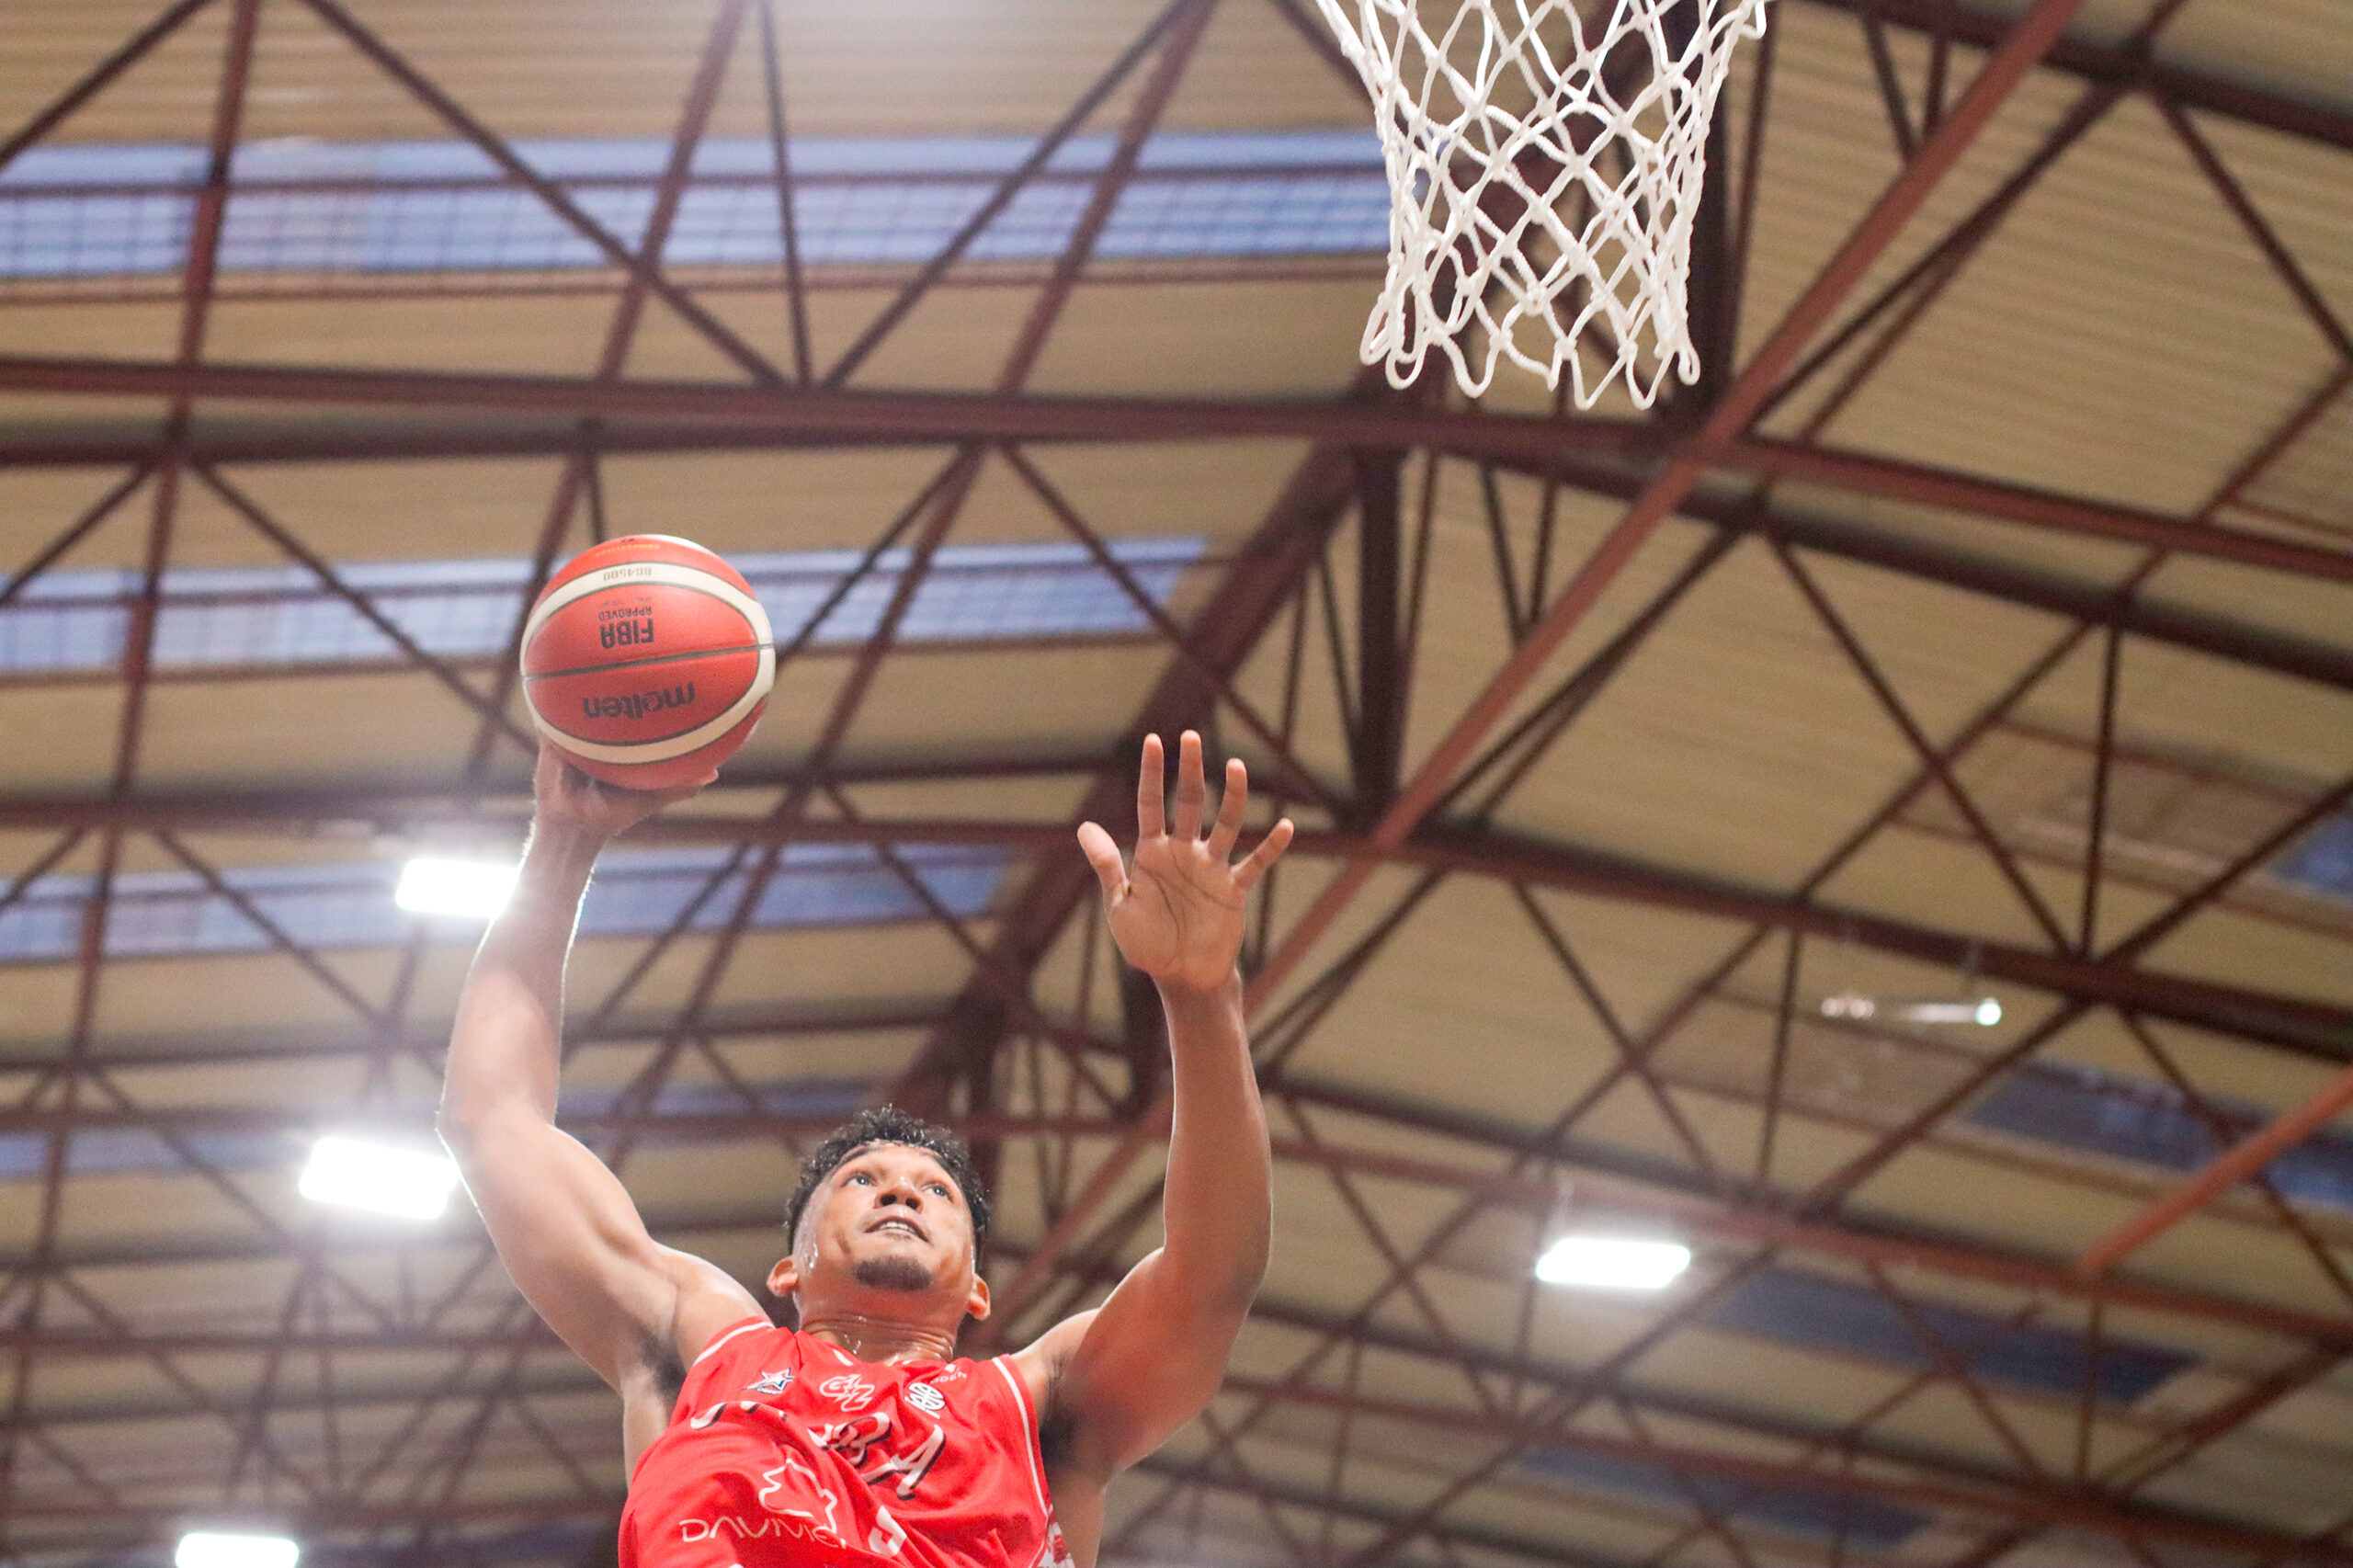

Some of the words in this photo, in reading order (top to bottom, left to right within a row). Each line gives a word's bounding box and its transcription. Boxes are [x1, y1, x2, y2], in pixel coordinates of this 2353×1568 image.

[598, 606, 653, 621] APPROVED
[600, 619, 654, 649] FIBA
[583, 682, 696, 720] molten
[679, 1516, 847, 1550] DAUNIE
